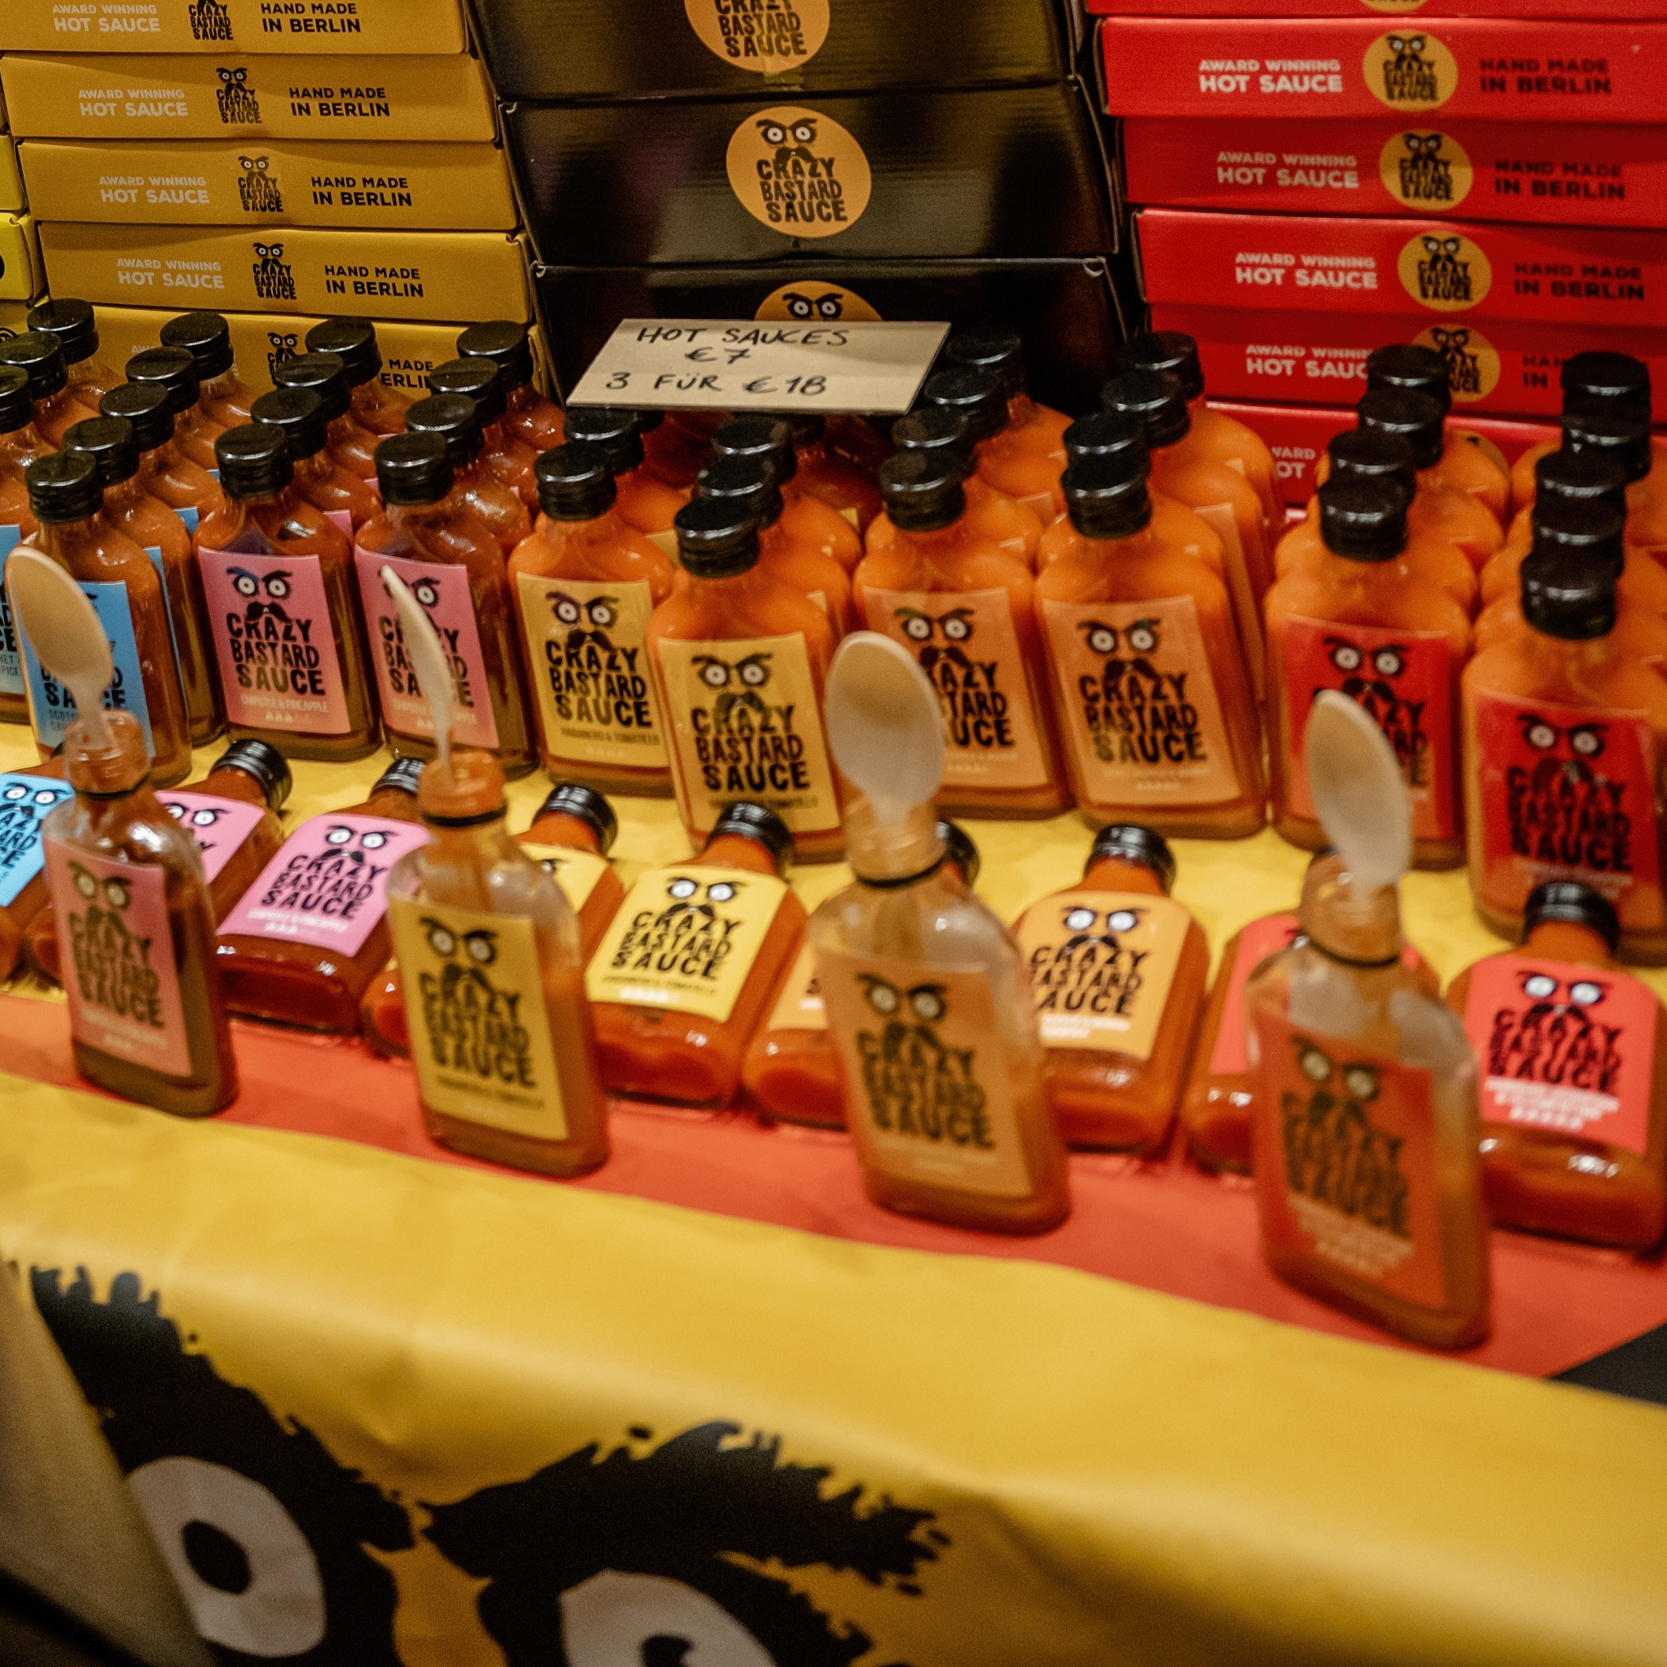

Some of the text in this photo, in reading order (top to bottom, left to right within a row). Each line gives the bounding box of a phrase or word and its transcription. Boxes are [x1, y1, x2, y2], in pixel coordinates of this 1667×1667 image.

[52, 4, 157, 15] AWARD WINNING
[188, 4, 228, 17] CRAZY
[260, 2, 357, 15] HAND MADE
[53, 17, 161, 32] HOT SAUCE
[190, 16, 231, 29] BASTARD
[192, 27, 234, 40] SAUCE
[261, 18, 361, 33] IN BERLIN
[718, 12, 801, 36] BASTARD
[724, 32, 807, 57] SAUCE
[78, 88, 185, 99] AWARD WINNING
[289, 87, 386, 99] HAND MADE
[79, 102, 189, 117] HOT SAUCE
[290, 102, 390, 117] IN BERLIN
[756, 157, 835, 180] CRAZY
[99, 176, 206, 187] AWARD WINNING
[311, 176, 408, 189] HAND MADE
[760, 179, 842, 202] BASTARD
[100, 189, 209, 204] HOT SAUCE
[312, 191, 413, 207] IN BERLIN
[766, 200, 848, 223] SAUCE
[636, 327, 850, 346] HOT SAUCES
[606, 372, 631, 389] 3
[653, 372, 722, 392] FÜR
[226, 612, 312, 642] CRAZY
[230, 638, 319, 668] BASTARD
[545, 640, 638, 672] CRAZY
[236, 664, 325, 695] SAUCE
[549, 667, 646, 699] BASTARD
[1079, 672, 1186, 702] CRAZY
[555, 694, 652, 728] SAUCE
[691, 705, 794, 735] CRAZY
[1085, 703, 1197, 733] BASTARD
[696, 734, 803, 763] BASTARD
[1093, 731, 1208, 763] SAUCE
[703, 761, 809, 791] SAUCE
[288, 854, 387, 882] CRAZY
[272, 872, 373, 901] BASTARD
[261, 889, 363, 919] SAUCE
[632, 911, 741, 936] CRAZY
[620, 931, 731, 960] BASTARD
[611, 951, 721, 980] SAUCE
